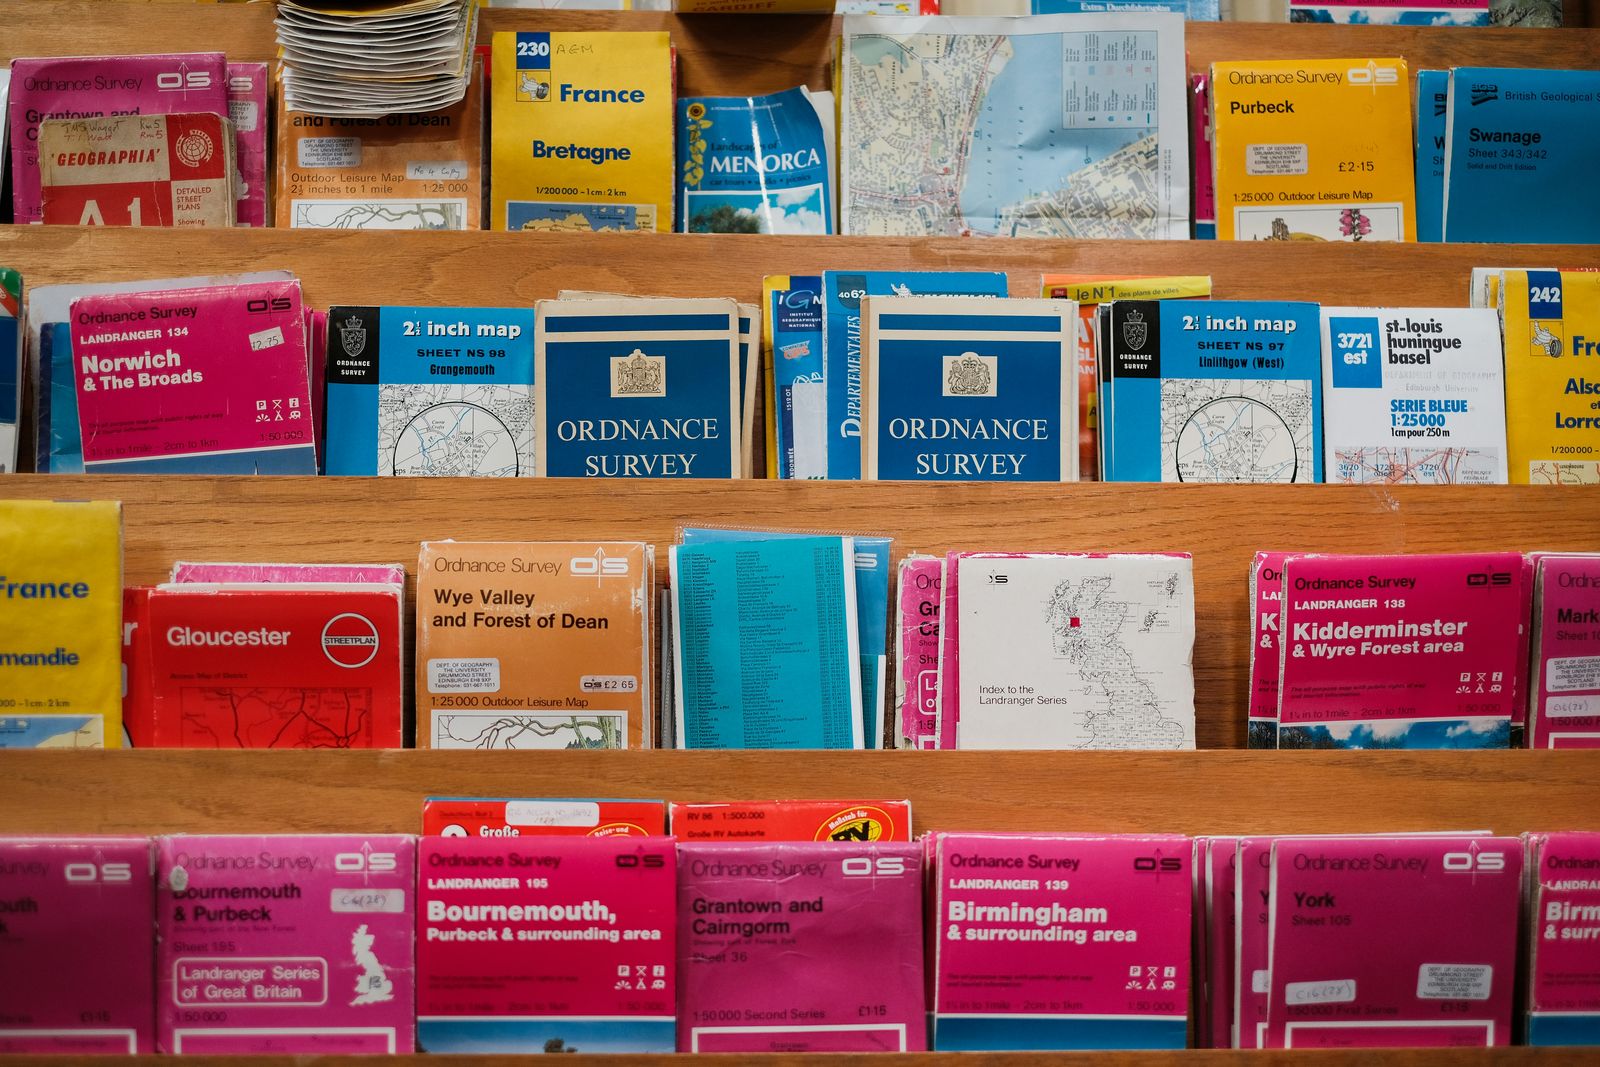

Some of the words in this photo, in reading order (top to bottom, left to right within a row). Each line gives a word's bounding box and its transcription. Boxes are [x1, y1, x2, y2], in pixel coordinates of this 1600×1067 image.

[517, 41, 549, 56] 230
[24, 77, 91, 91] Ordnance
[95, 77, 143, 92] Survey
[1229, 71, 1293, 85] Ordnance
[1296, 70, 1342, 85] Survey
[560, 84, 645, 103] France
[1505, 92, 1536, 100] British
[1541, 92, 1592, 103] Geological
[1230, 101, 1295, 115] Purbeck
[293, 113, 323, 127] and
[387, 113, 400, 127] of
[409, 113, 450, 126] Dean
[1469, 128, 1541, 146] Swanage
[533, 140, 631, 165] Bretagne
[711, 148, 821, 173] MENORCA
[1468, 150, 1497, 158] Sheet
[1501, 150, 1547, 159] 343/342
[291, 173, 337, 182] Outdoor
[340, 174, 379, 182] Leisure
[382, 173, 404, 184] Map
[176, 187, 211, 195] DETAILED
[308, 185, 343, 193] inches
[361, 185, 365, 193] 1
[371, 185, 392, 193] mile
[1279, 192, 1315, 201] Outdoor
[1318, 191, 1349, 200] Leisure
[1353, 191, 1373, 200] Map
[177, 195, 202, 203] STREET
[178, 218, 205, 226] Showing
[1077, 289, 1089, 300] le
[1132, 289, 1150, 297] plans
[1531, 287, 1561, 303] 242
[79, 310, 146, 325] Ordnance
[150, 306, 197, 320] Survey
[428, 321, 470, 336] inch
[477, 323, 521, 340] map
[1206, 316, 1247, 332] inch
[1253, 318, 1297, 334] map
[1386, 318, 1443, 334] st-louis
[80, 330, 162, 345] LANDRANGER
[168, 327, 189, 338] 134
[1337, 333, 1372, 349] 3721
[1387, 334, 1462, 352] huningue
[1198, 342, 1240, 350] SHEET
[1246, 342, 1263, 350] NS
[1269, 342, 1285, 350] 97
[82, 349, 181, 374] Norwich
[1199, 356, 1247, 369] Linlithgow
[1252, 357, 1284, 369] (West)
[1344, 351, 1367, 365] est
[1388, 349, 1431, 365] basel
[430, 364, 495, 377] Grangemouth
[83, 378, 96, 391] &
[100, 376, 134, 390] The
[138, 370, 203, 387] Broads
[1390, 400, 1426, 412] SERIE
[1429, 400, 1467, 412] BLEUE
[557, 418, 719, 442] ORDNANCE
[889, 418, 1048, 441] ORDNANCE
[1407, 429, 1425, 438] pour
[1426, 428, 1442, 437] 250
[586, 453, 697, 477] SURVEY
[916, 453, 1026, 476] SURVEY
[435, 557, 505, 573] Ordnance
[511, 558, 562, 576] Survey
[1295, 577, 1364, 590] Ordnance
[1367, 576, 1416, 590] Survey
[434, 589, 473, 607] Wye
[480, 589, 535, 608] Valley
[1294, 600, 1377, 610] LANDRANGER
[1383, 600, 1406, 608] 138
[433, 612, 466, 627] and
[473, 612, 531, 628] Forest
[537, 613, 555, 629] of
[562, 614, 608, 629] Dean
[167, 626, 291, 647] Gloucester
[1293, 620, 1468, 641] Kidderminster
[1556, 630, 1589, 641] Sheet
[1292, 645, 1305, 658] &
[1310, 645, 1356, 660] Wyre
[1360, 642, 1419, 655] Forest
[1423, 641, 1464, 653] area
[979, 685, 1005, 695] Index
[1007, 686, 1016, 695] to
[1018, 686, 1034, 695] the
[482, 697, 524, 707] Outdoor
[527, 697, 562, 707] Leisure
[565, 698, 588, 708] Map
[979, 696, 1034, 706] Landranger
[1037, 696, 1068, 705] Series
[175, 852, 255, 871] Ordnance
[259, 852, 318, 872] Survey
[428, 853, 504, 867] Ordnance
[508, 853, 561, 869] Survey
[692, 860, 767, 877] Ordnance
[772, 860, 827, 877] Survey
[950, 854, 1023, 868] Ordnance
[1027, 855, 1080, 871] Survey
[1294, 853, 1370, 871] Ordnance
[1373, 853, 1428, 873] Survey
[428, 878, 519, 889] LANDRANGER
[526, 879, 548, 888] 195
[950, 879, 1039, 890] LANDRANGER
[1045, 880, 1069, 890] 139
[692, 898, 782, 914] Grantown
[789, 897, 823, 913] and
[1294, 892, 1335, 908] York
[174, 906, 186, 921] &
[194, 906, 271, 921] Purbeck
[427, 900, 617, 924] Bournemouth,
[949, 901, 1108, 926] Birmingham
[692, 919, 790, 937] Cairngorm
[1292, 914, 1326, 927] Sheet
[427, 927, 498, 941] Purbeck
[501, 928, 513, 940] &
[518, 927, 620, 942] surrounding
[623, 930, 661, 940] area
[947, 925, 961, 941] &
[966, 926, 1087, 944] surrounding
[1092, 928, 1137, 942] area
[175, 942, 209, 952] Sheet
[182, 966, 265, 983] Landranger
[273, 966, 320, 979] Series
[182, 985, 198, 998] of
[205, 985, 246, 999] Great
[253, 985, 302, 998] Britain
[744, 1010, 787, 1021] Second
[790, 1009, 826, 1019] Series
